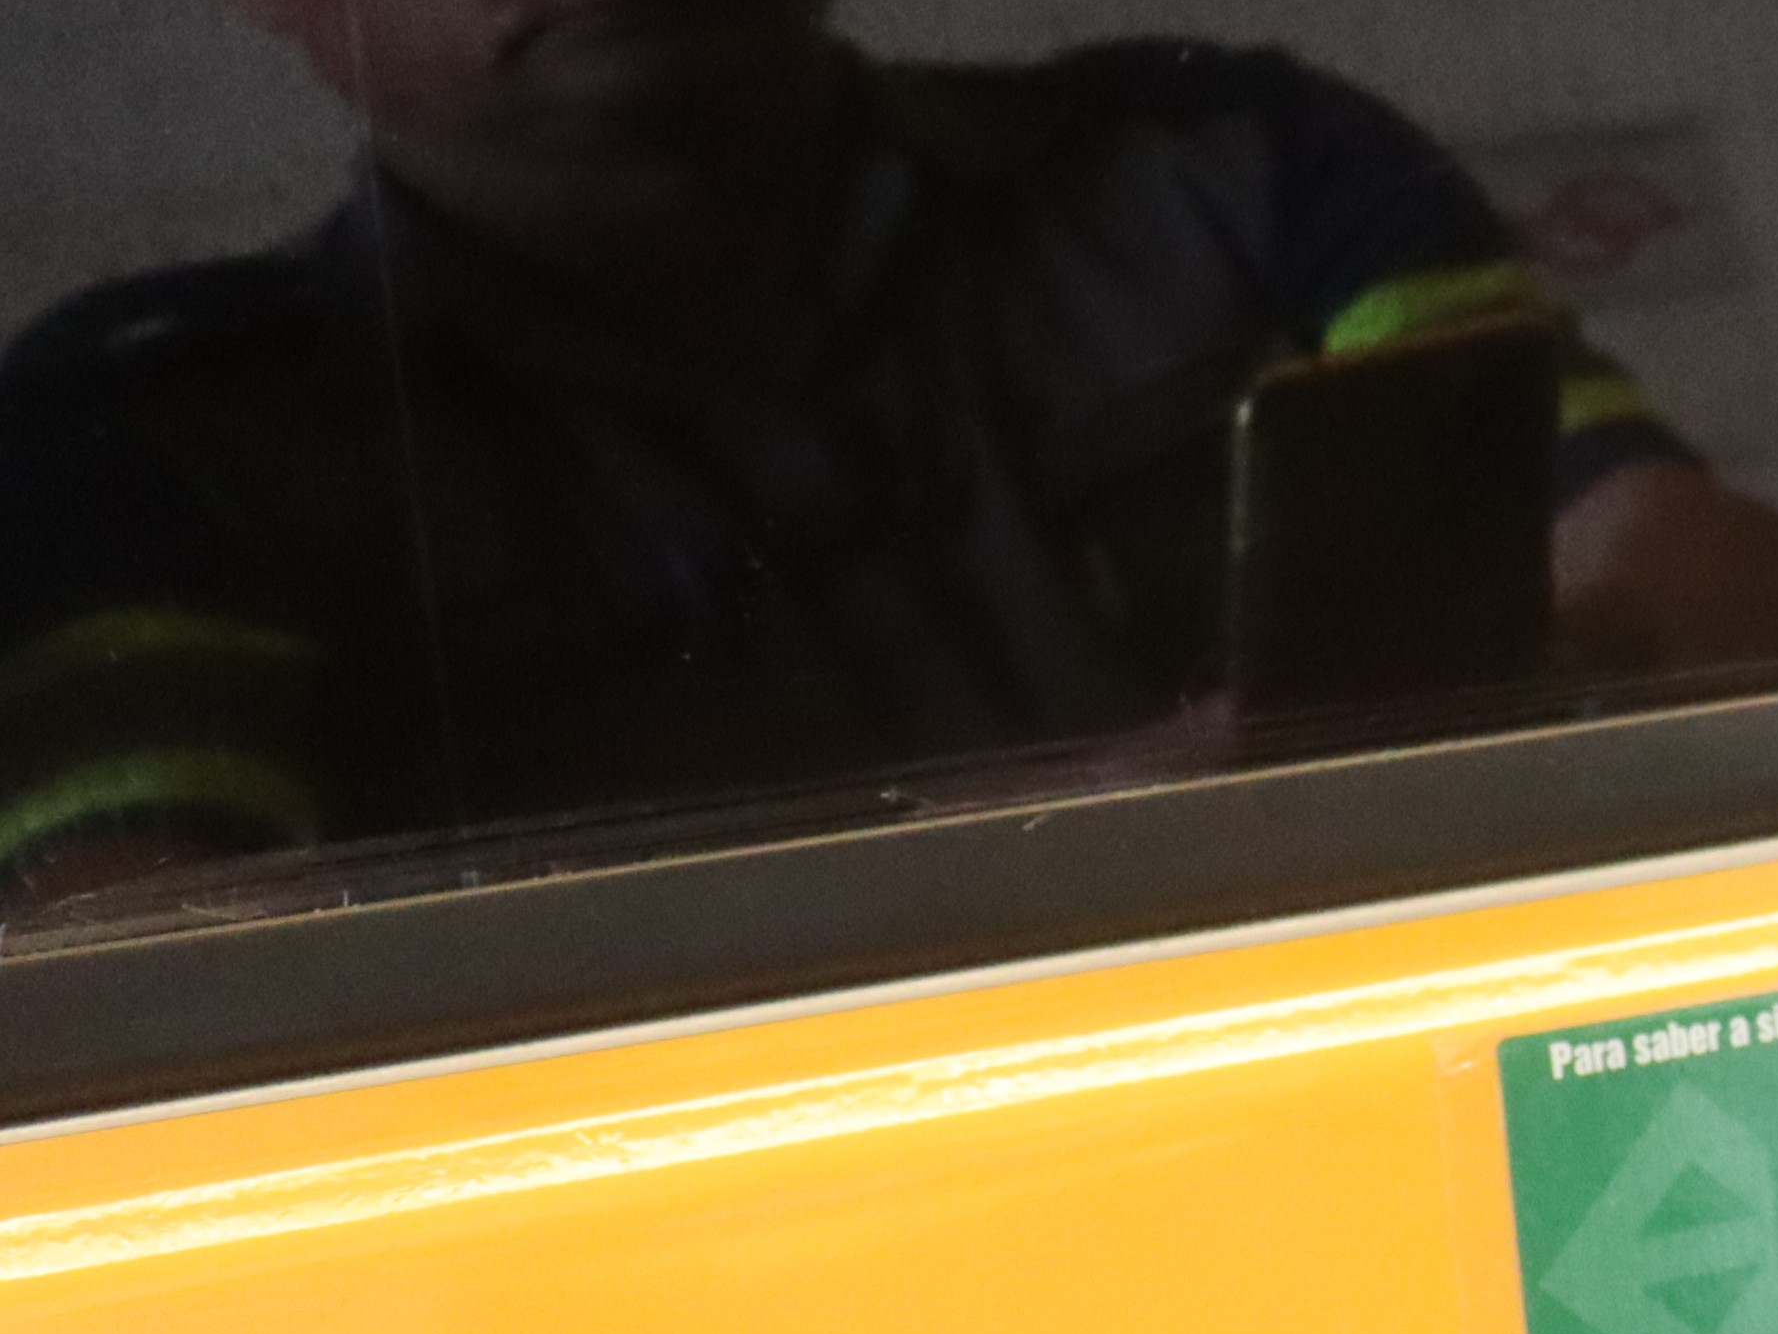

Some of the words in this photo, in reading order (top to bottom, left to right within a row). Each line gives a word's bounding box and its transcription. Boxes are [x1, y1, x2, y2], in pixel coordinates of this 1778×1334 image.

[1549, 1037, 1627, 1080] Para
[1633, 1019, 1721, 1067] saber
[1729, 1015, 1750, 1048] a
